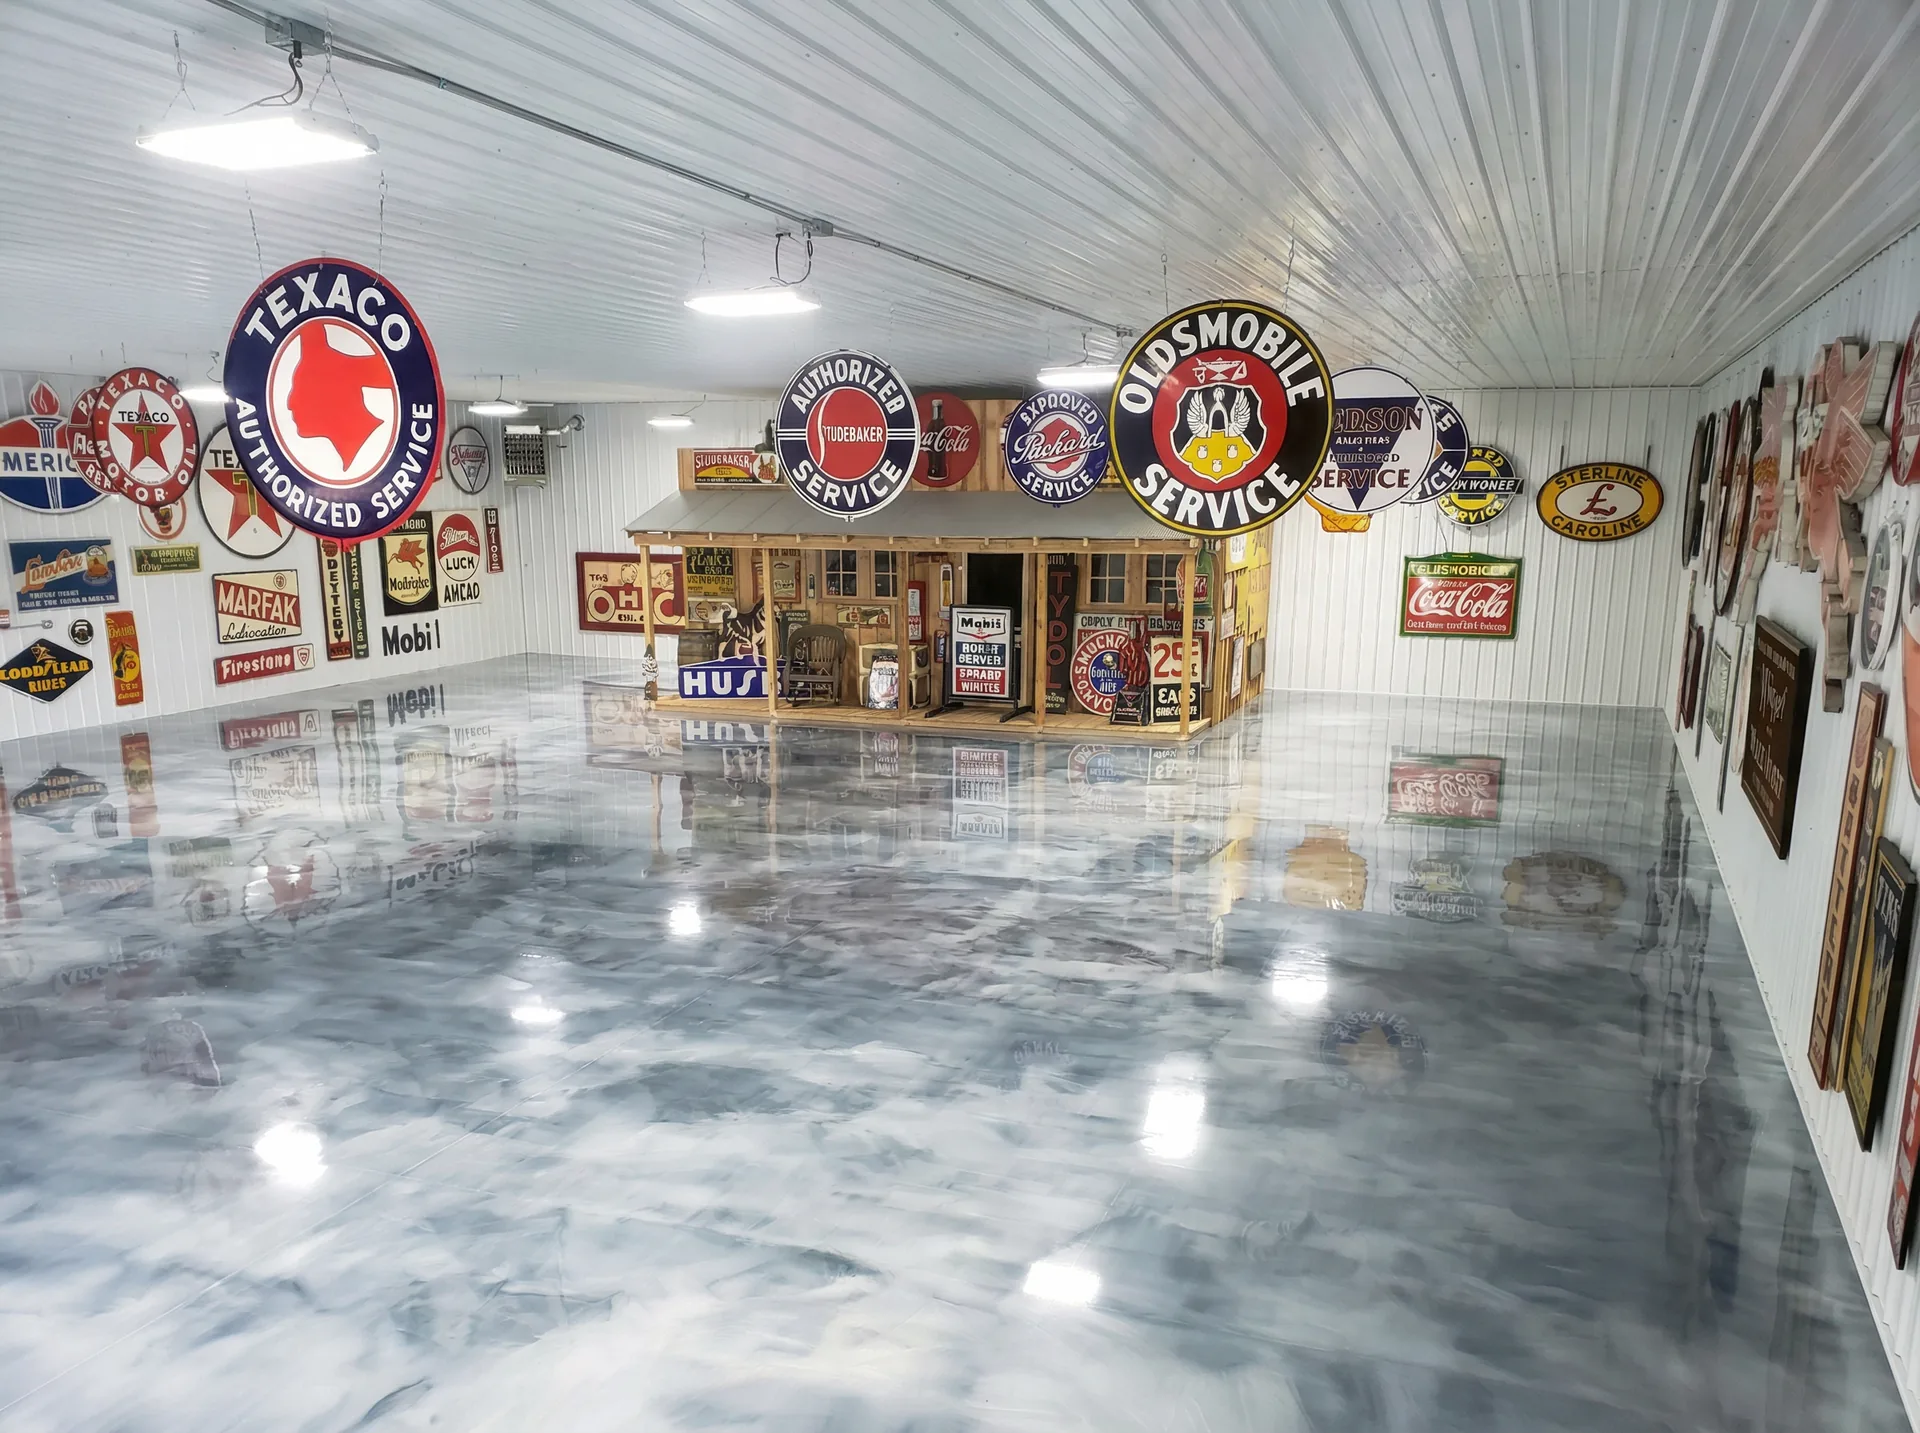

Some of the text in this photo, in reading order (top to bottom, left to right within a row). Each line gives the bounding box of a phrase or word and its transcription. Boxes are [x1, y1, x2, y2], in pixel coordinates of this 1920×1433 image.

[244, 271, 411, 352] TEXACO
[1119, 311, 1325, 414] OLDSMOBILE
[97, 372, 184, 411] TEXACO
[118, 410, 170, 423] TEXACO
[235, 397, 433, 528] AUTHORIZED SERVICE
[792, 458, 903, 508] SERVICE
[1021, 469, 1094, 498] SERVICE
[1132, 462, 1301, 529] SERVICE
[1551, 514, 1645, 538] CAROLINE
[446, 556, 476, 571] LUCK
[218, 582, 298, 625] MARFAK
[381, 618, 441, 657] Mobil
